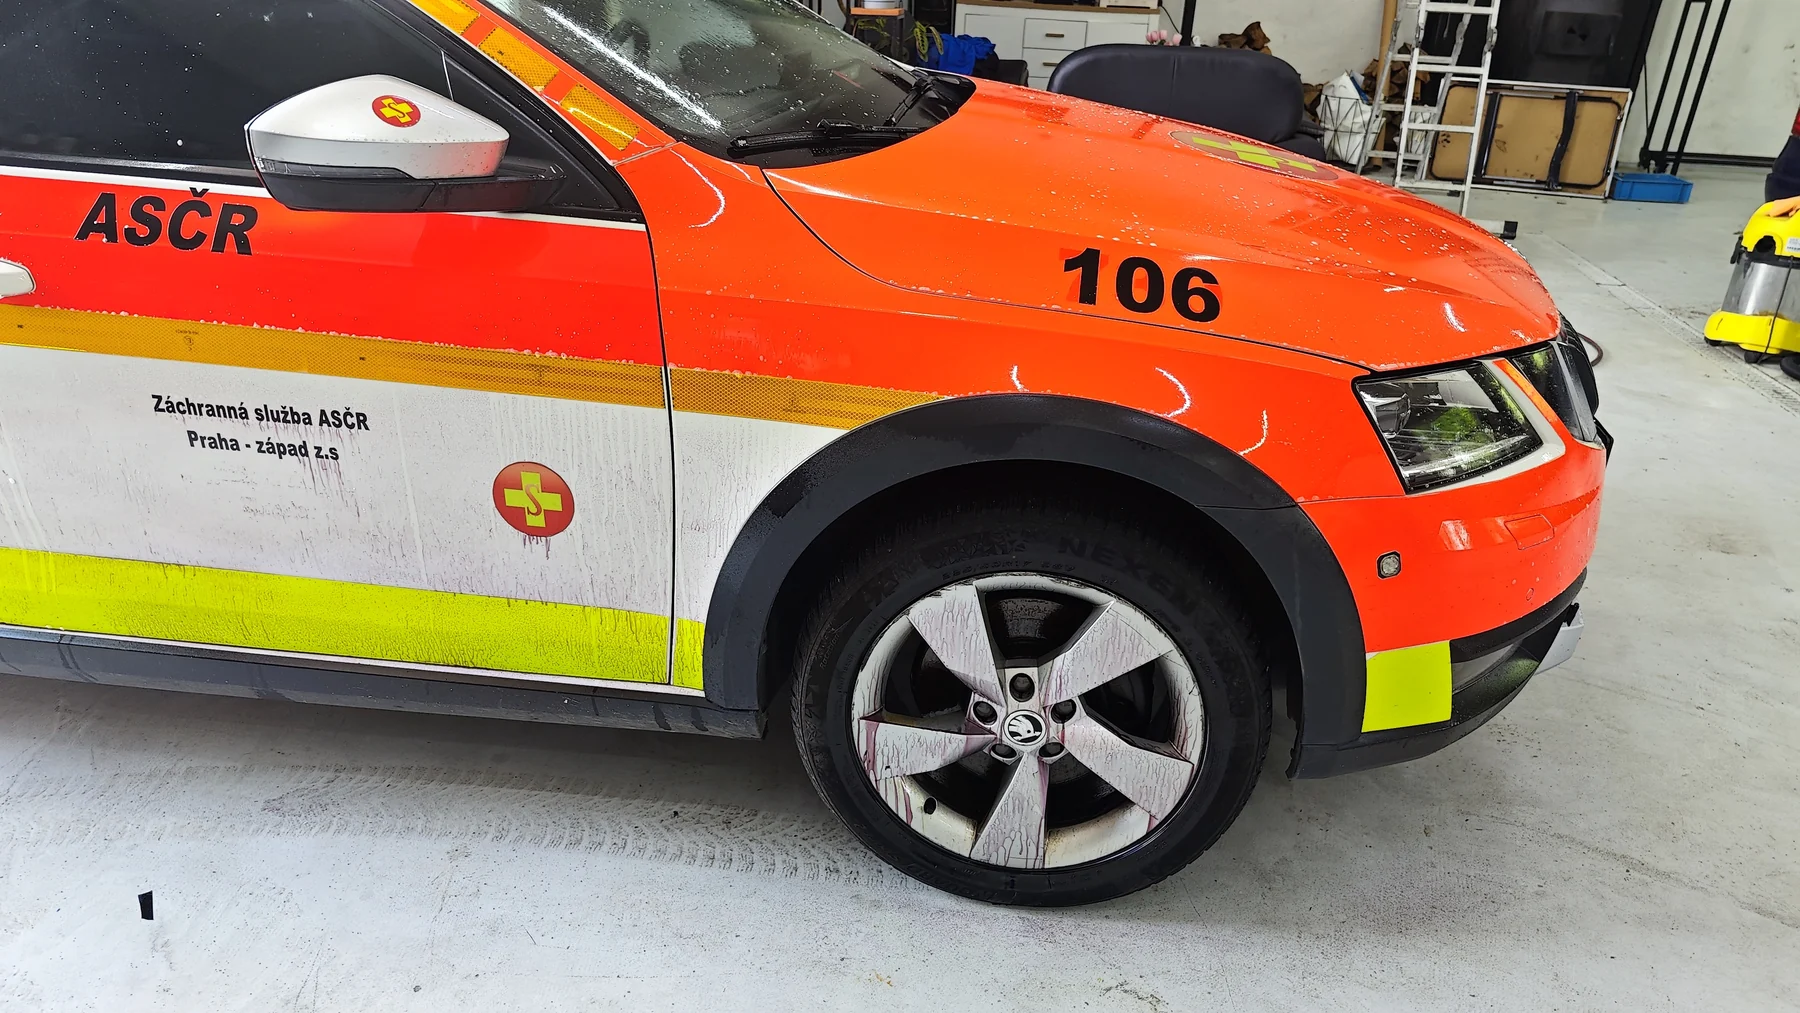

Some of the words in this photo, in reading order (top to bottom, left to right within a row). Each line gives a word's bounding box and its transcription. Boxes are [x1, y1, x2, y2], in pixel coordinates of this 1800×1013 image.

[74, 187, 258, 256] ASČR
[1064, 247, 1221, 323] 106
[151, 394, 249, 420] Záchranná
[254, 404, 313, 426] služba
[319, 406, 370, 431] ASČR
[186, 429, 241, 452] Praha
[255, 436, 309, 459] západ
[313, 445, 340, 461] z.s
[1057, 536, 1199, 616] NEXEN
